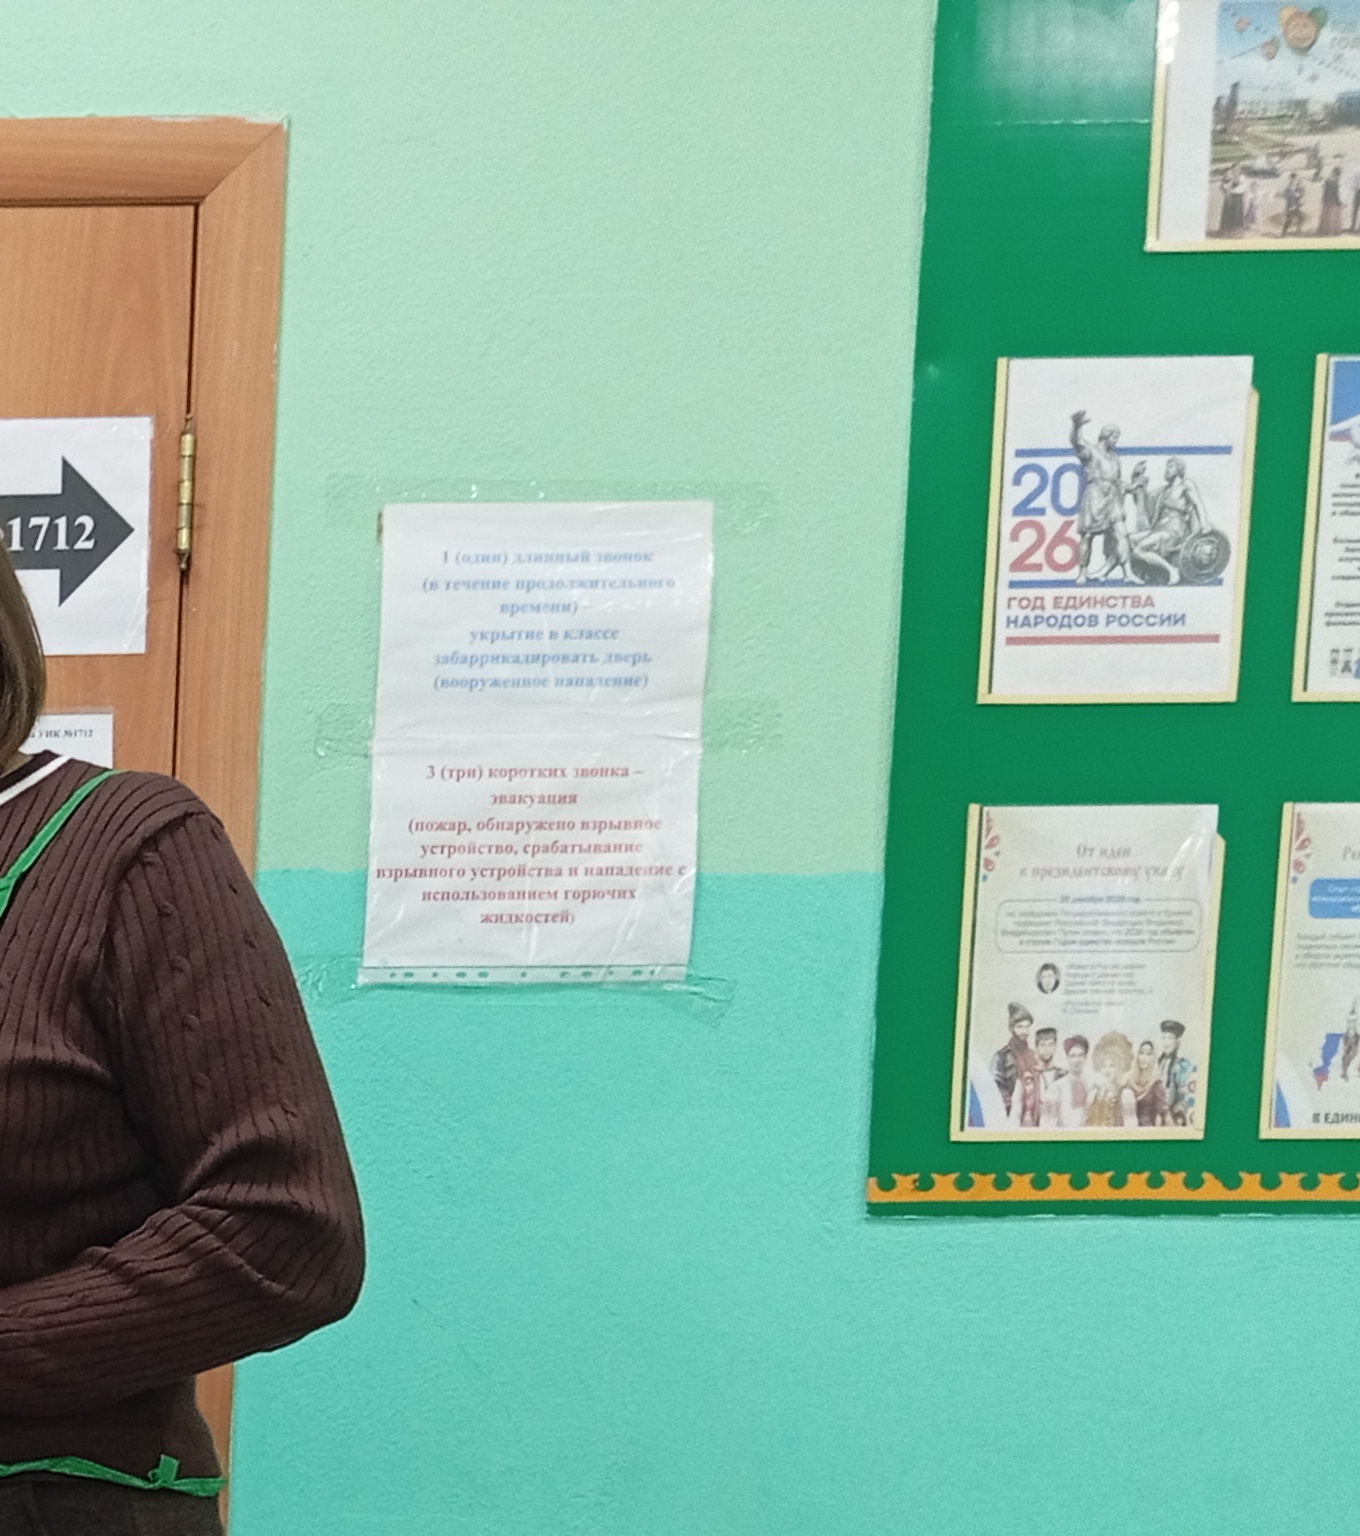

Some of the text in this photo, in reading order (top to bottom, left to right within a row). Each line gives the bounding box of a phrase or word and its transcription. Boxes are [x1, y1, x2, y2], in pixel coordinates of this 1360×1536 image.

[1012, 463, 1086, 517] 20
[1009, 520, 1080, 573] 26
[455, 550, 508, 565] (один)
[512, 550, 590, 565] длинный
[596, 550, 654, 563] звонок
[443, 579, 511, 590] течение
[500, 601, 579, 616] времени)
[1007, 595, 1156, 610] ГОД ЕДИНСТВА
[1006, 613, 1187, 629] НАРОДОВ РОССИИ
[469, 629, 544, 644] укрытие
[564, 629, 620, 640] классе
[441, 766, 483, 780] (три)
[488, 766, 567, 780] коротких
[574, 767, 629, 778] звонка
[490, 793, 578, 807] эвакуация
[476, 818, 575, 834] обнаружено
[581, 819, 662, 834] взрывное
[523, 841, 643, 857] срабатывание
[470, 864, 563, 880] устройства
[584, 865, 673, 878] нападение
[420, 888, 558, 903] использованием
